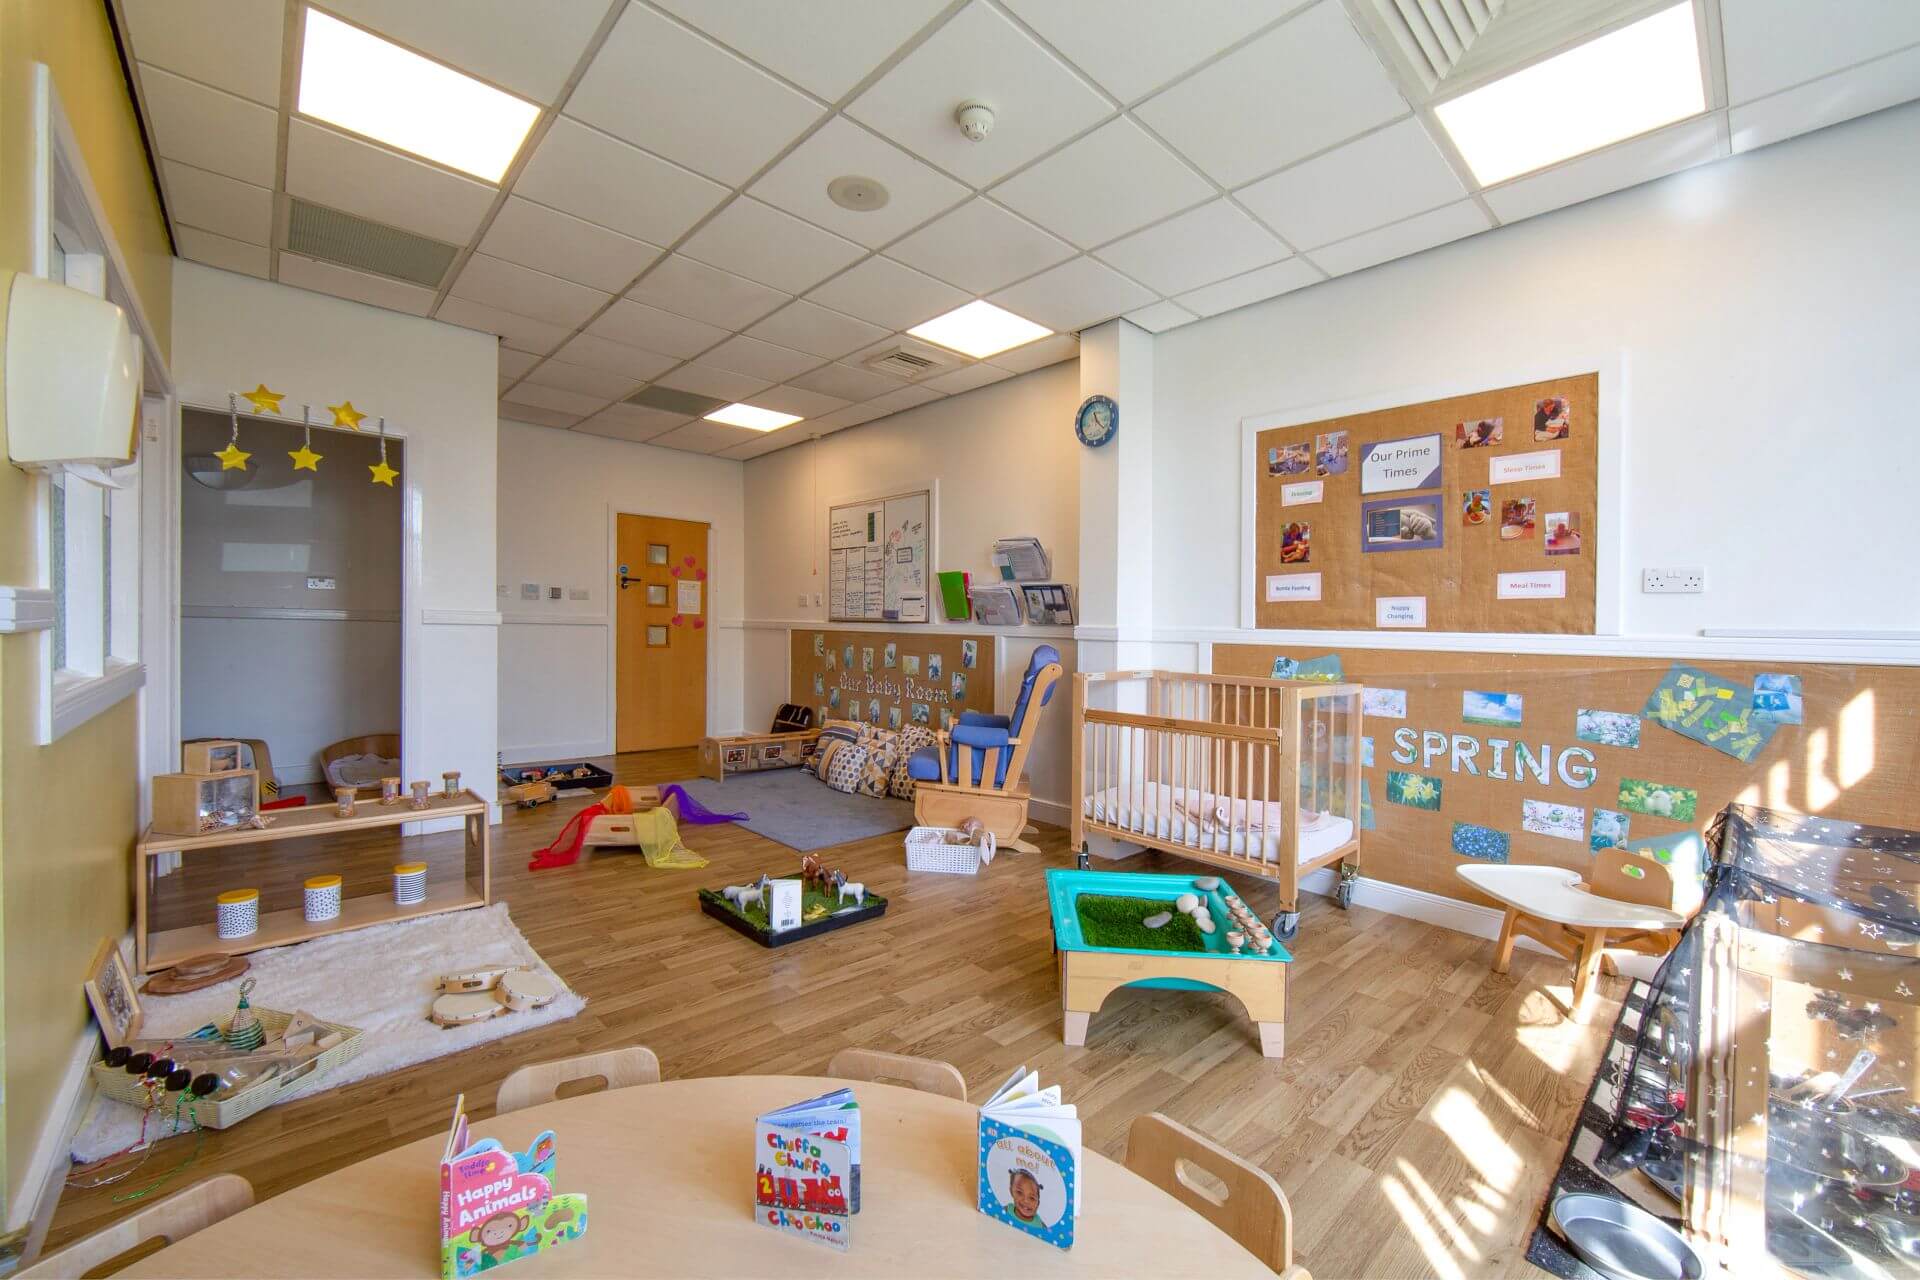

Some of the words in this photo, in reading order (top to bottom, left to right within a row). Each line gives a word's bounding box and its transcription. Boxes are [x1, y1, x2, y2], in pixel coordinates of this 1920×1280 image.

[1370, 452, 1392, 462] Our
[1396, 447, 1430, 459] Prime
[1383, 467, 1417, 479] Times
[865, 673, 900, 704] Baby
[905, 677, 948, 704] Room
[1391, 727, 1597, 789] SPRING
[766, 1133, 821, 1158] Chuffa
[1017, 1143, 1055, 1169] about
[775, 1150, 830, 1177] Chuffa
[457, 1175, 513, 1206] Happy
[760, 1177, 772, 1194] 2
[459, 1186, 537, 1227] Animals
[768, 1210, 803, 1230] Choo
[804, 1215, 841, 1232] Choo
